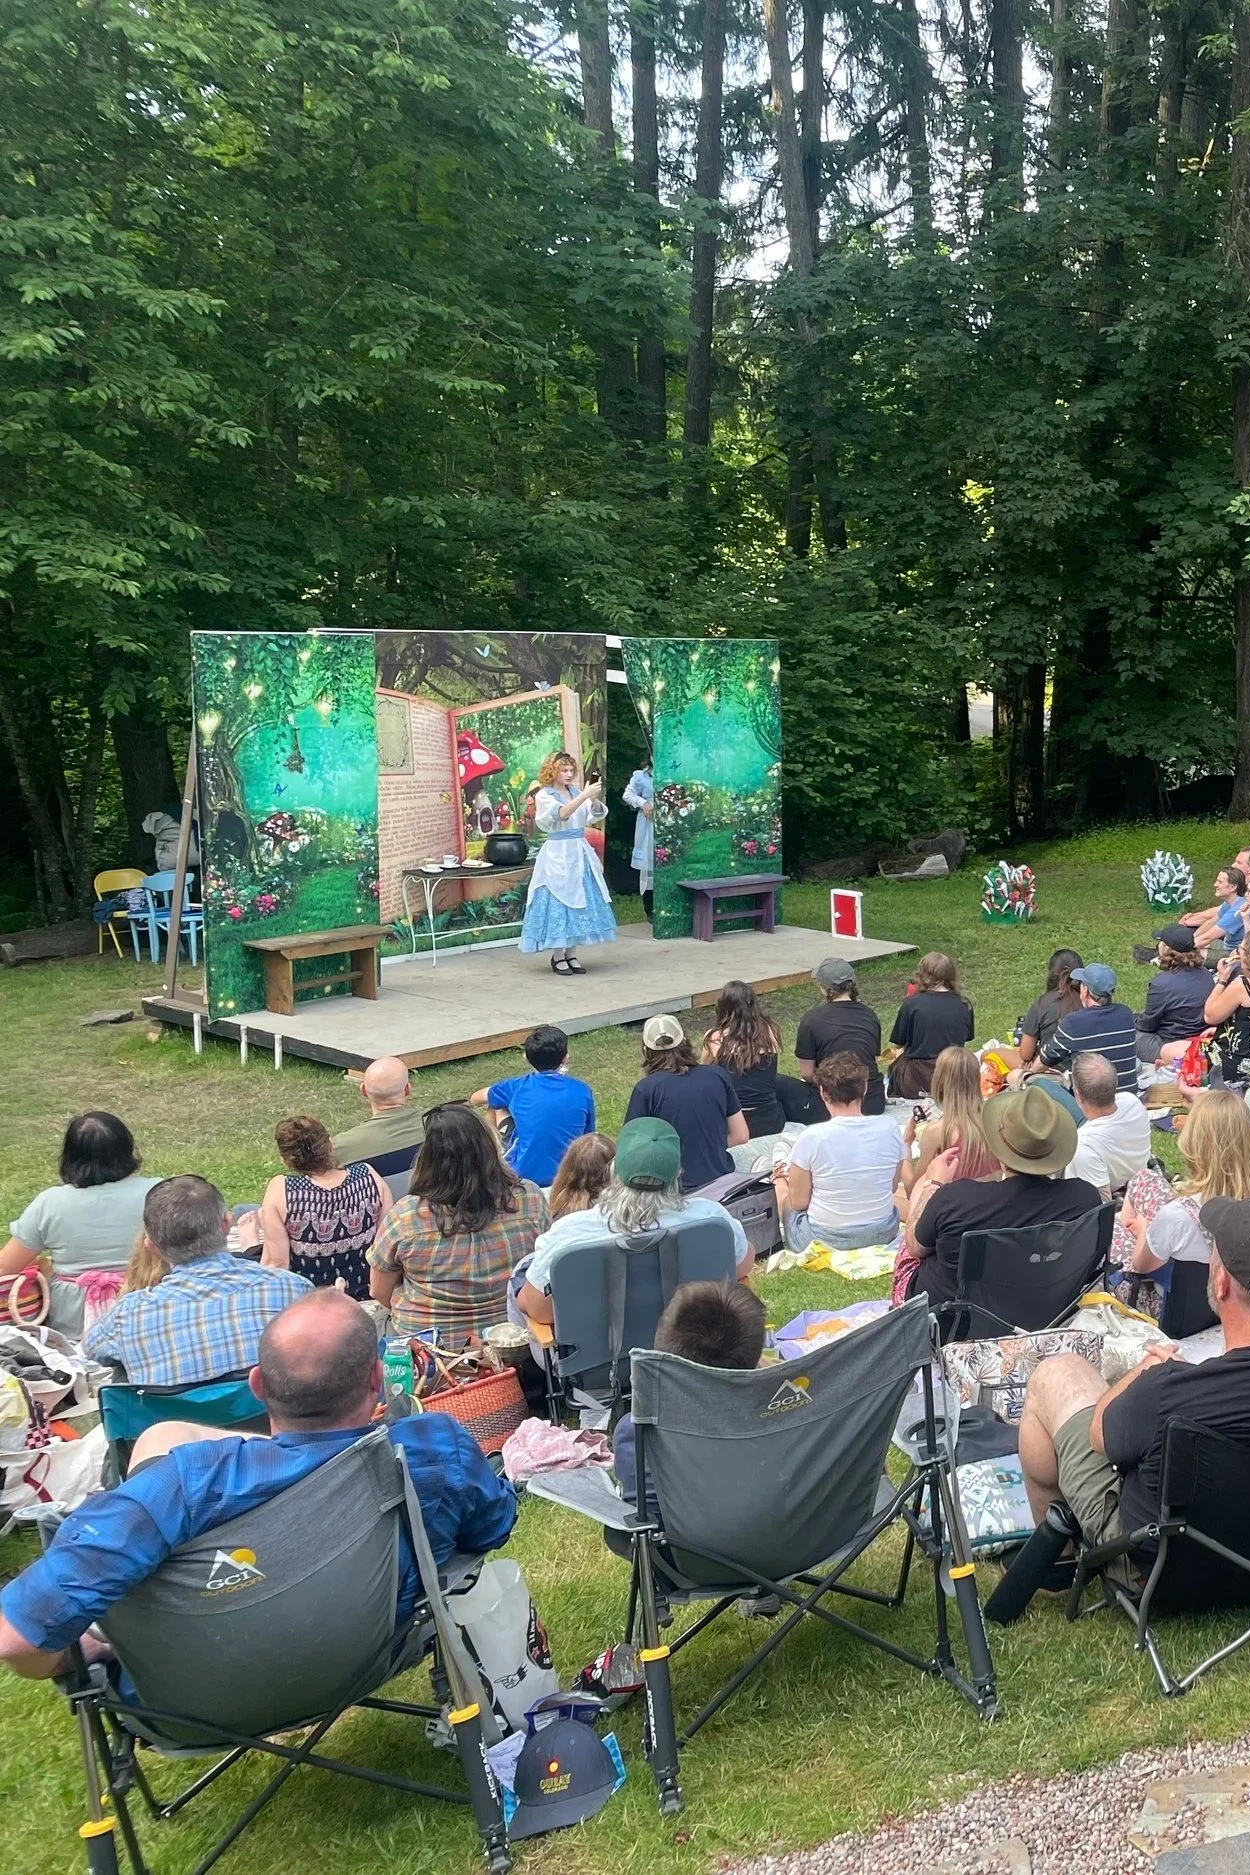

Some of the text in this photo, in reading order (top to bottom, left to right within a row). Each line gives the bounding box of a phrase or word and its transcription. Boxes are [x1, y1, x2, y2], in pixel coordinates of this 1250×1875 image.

[767, 1393, 801, 1410] GCI
[206, 1570, 251, 1590] GCI
[647, 1690, 657, 1749] KICKBACK
[479, 1742, 497, 1799] KICKBACK
